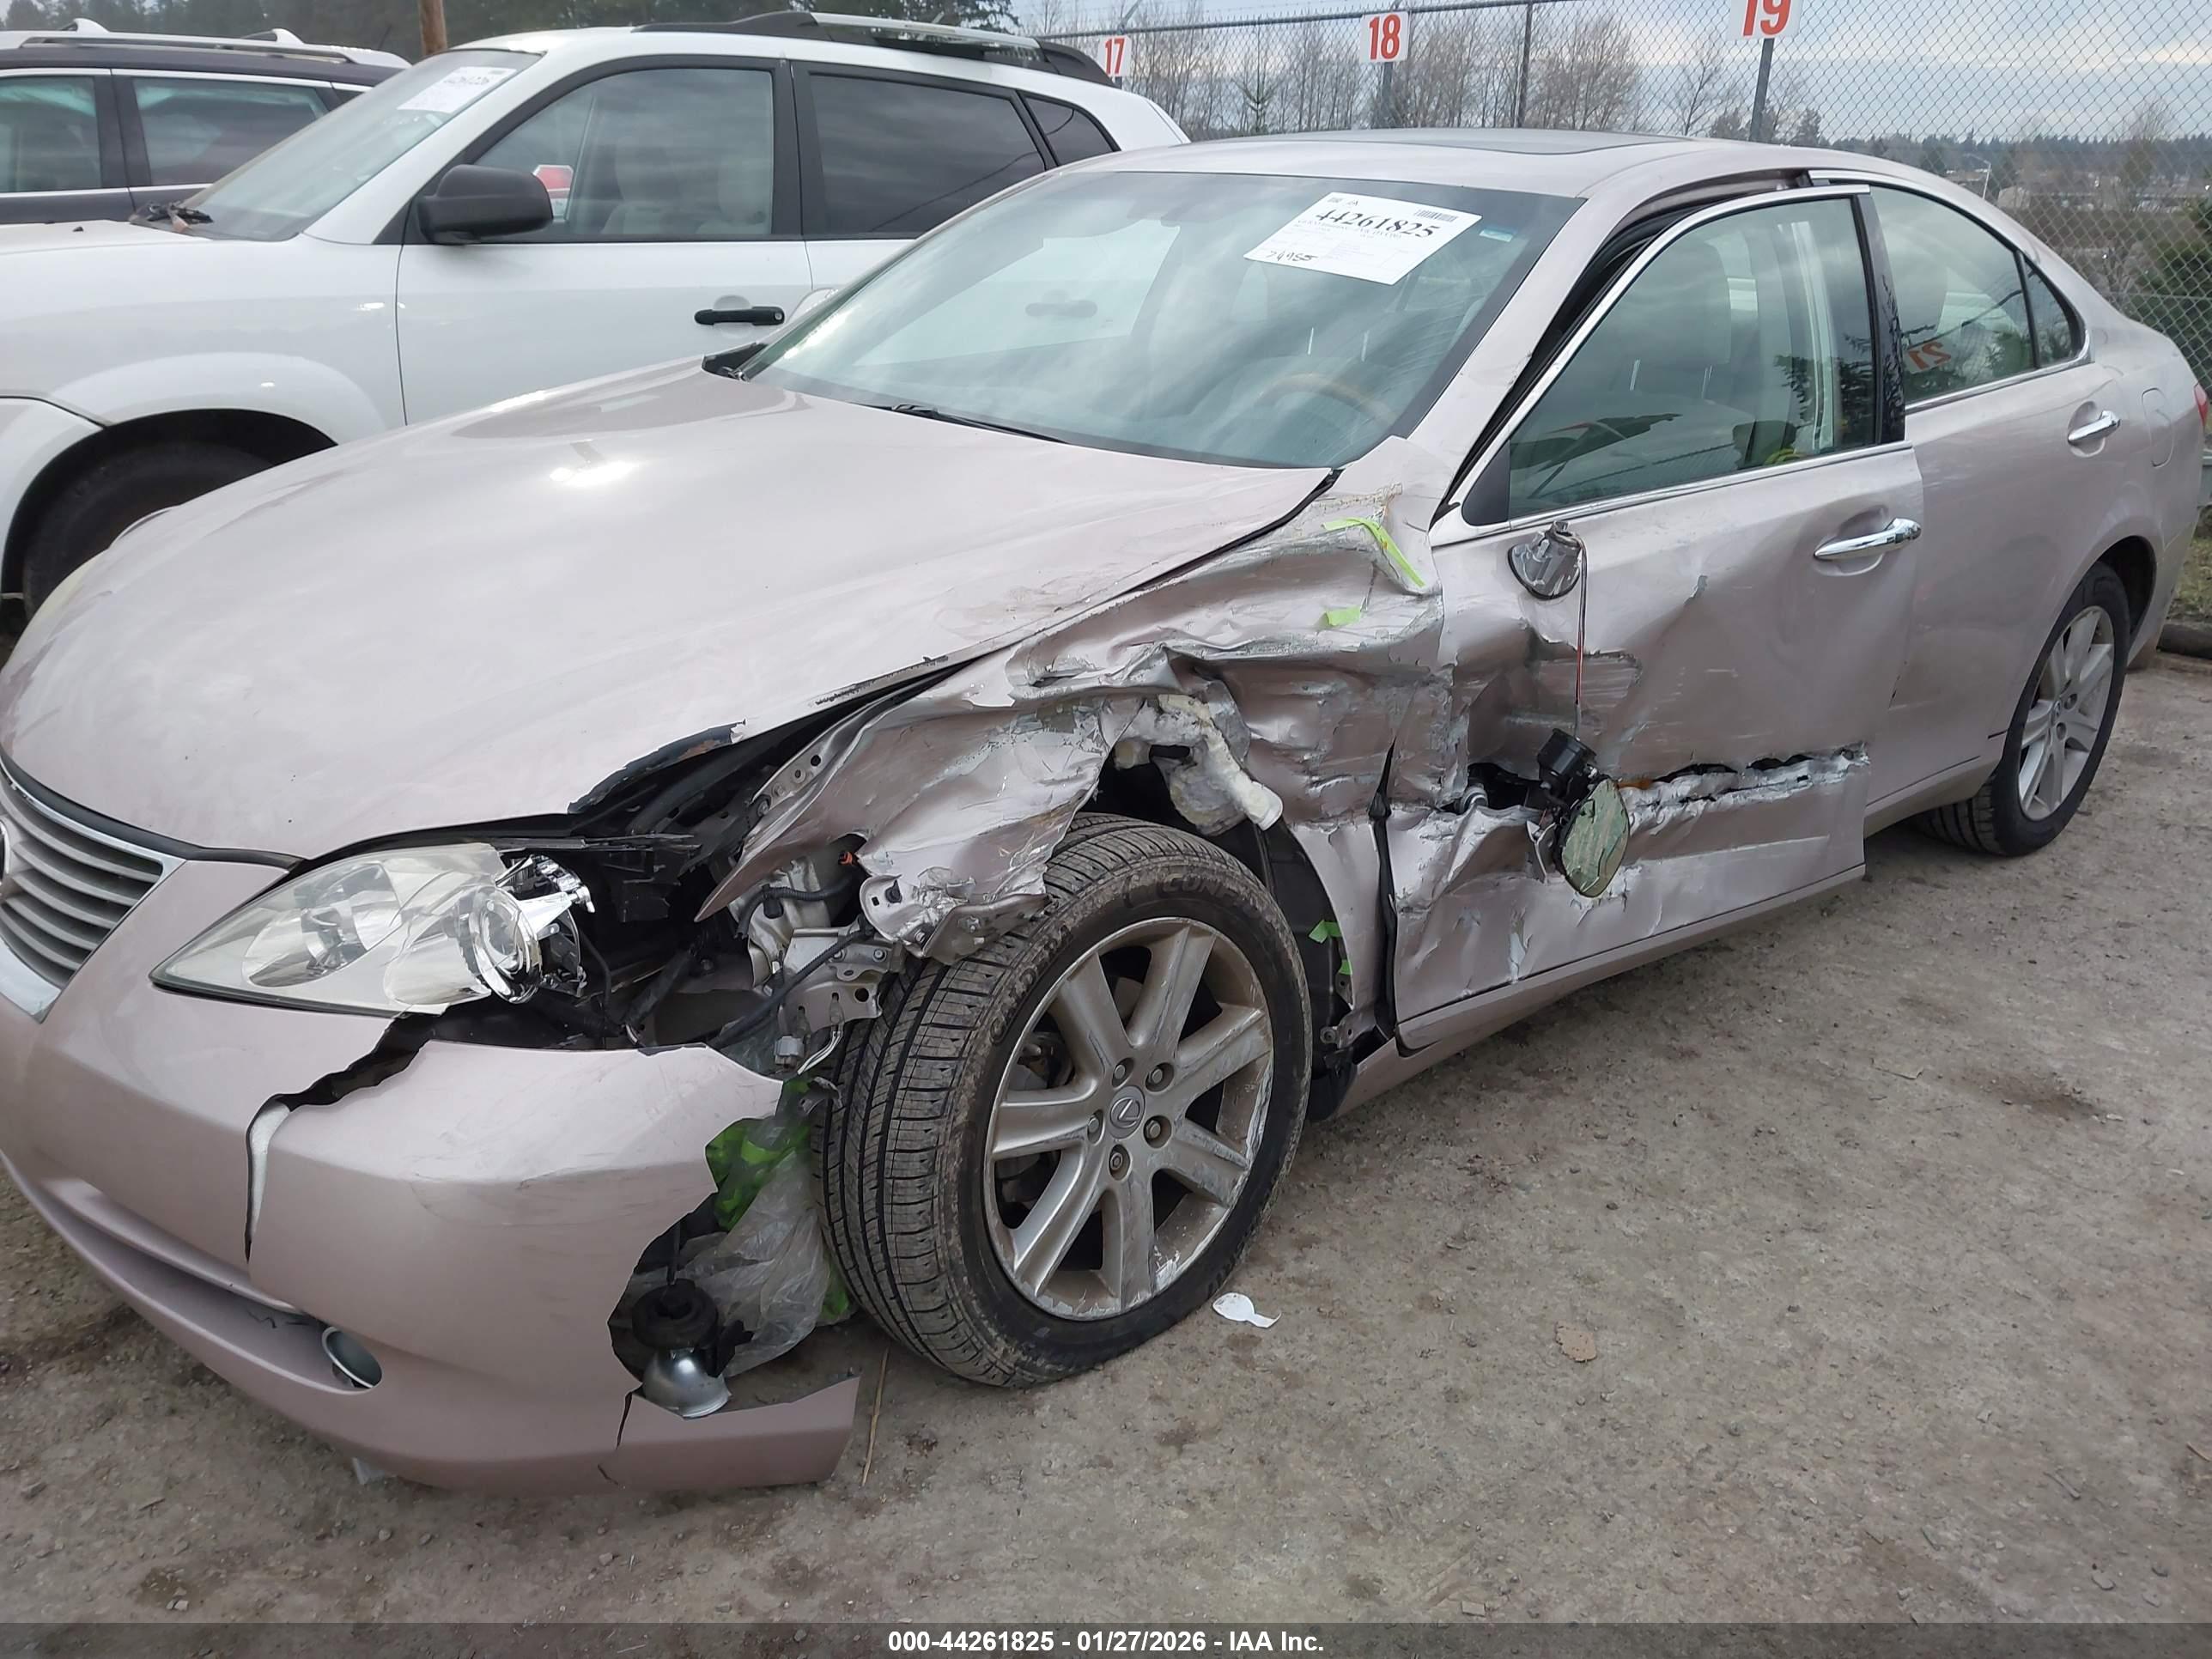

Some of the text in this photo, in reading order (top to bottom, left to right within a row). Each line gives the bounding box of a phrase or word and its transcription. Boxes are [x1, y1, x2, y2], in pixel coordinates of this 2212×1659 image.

[1743, 0, 1791, 36] 19
[1370, 14, 1401, 60] 18
[1105, 38, 1125, 75] 17
[1316, 209, 1440, 238] 44261825
